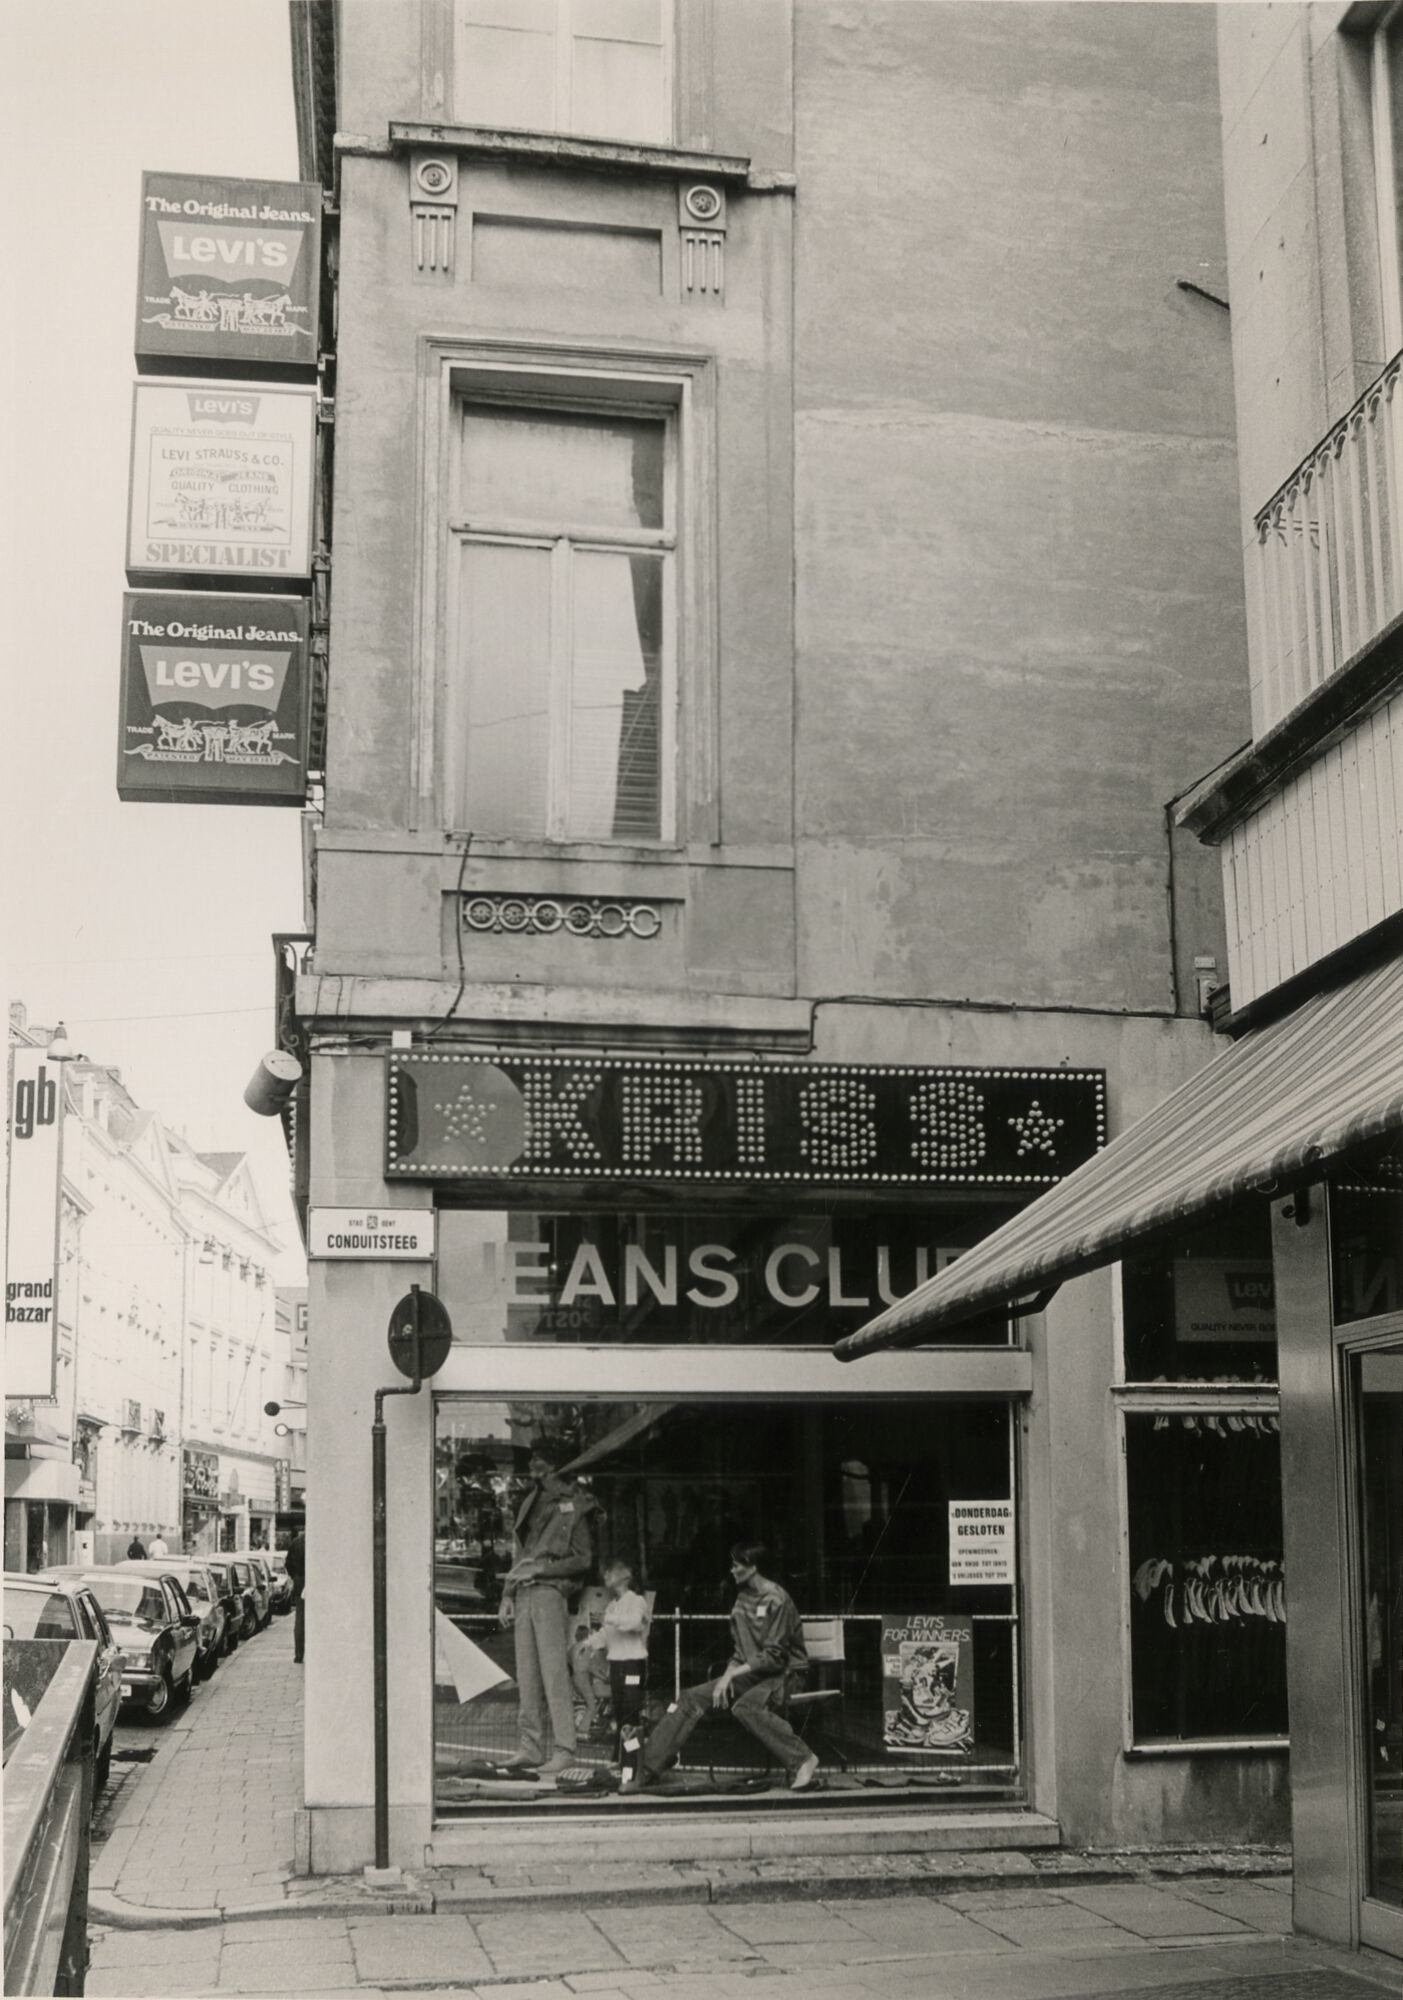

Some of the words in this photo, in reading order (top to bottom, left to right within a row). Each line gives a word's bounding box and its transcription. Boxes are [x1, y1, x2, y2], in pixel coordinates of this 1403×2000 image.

[145, 196, 180, 214] The
[183, 200, 257, 220] Original
[259, 206, 316, 223] Jeans.
[162, 448, 190, 461] LEVI
[195, 448, 249, 463] STRAUSS
[251, 454, 260, 465] &
[171, 480, 215, 492] QUALITY
[228, 483, 280, 496] CLOTHING
[146, 543, 292, 568] SPECIALIST
[128, 620, 165, 636] The
[167, 622, 244, 642] Original
[245, 626, 304, 642] Jeans.
[16, 1066, 58, 1139] gb
[327, 1234, 418, 1250] CONDUITSTEEG
[764, 1242, 966, 1308] CLU
[6, 1278, 53, 1300] grand
[6, 1304, 53, 1324] bazar
[954, 1507, 1009, 1519] DONDERDAG
[958, 1524, 1005, 1536] GESLOTEN
[906, 1616, 944, 1629] LEVI'S
[883, 1628, 909, 1641] FOR
